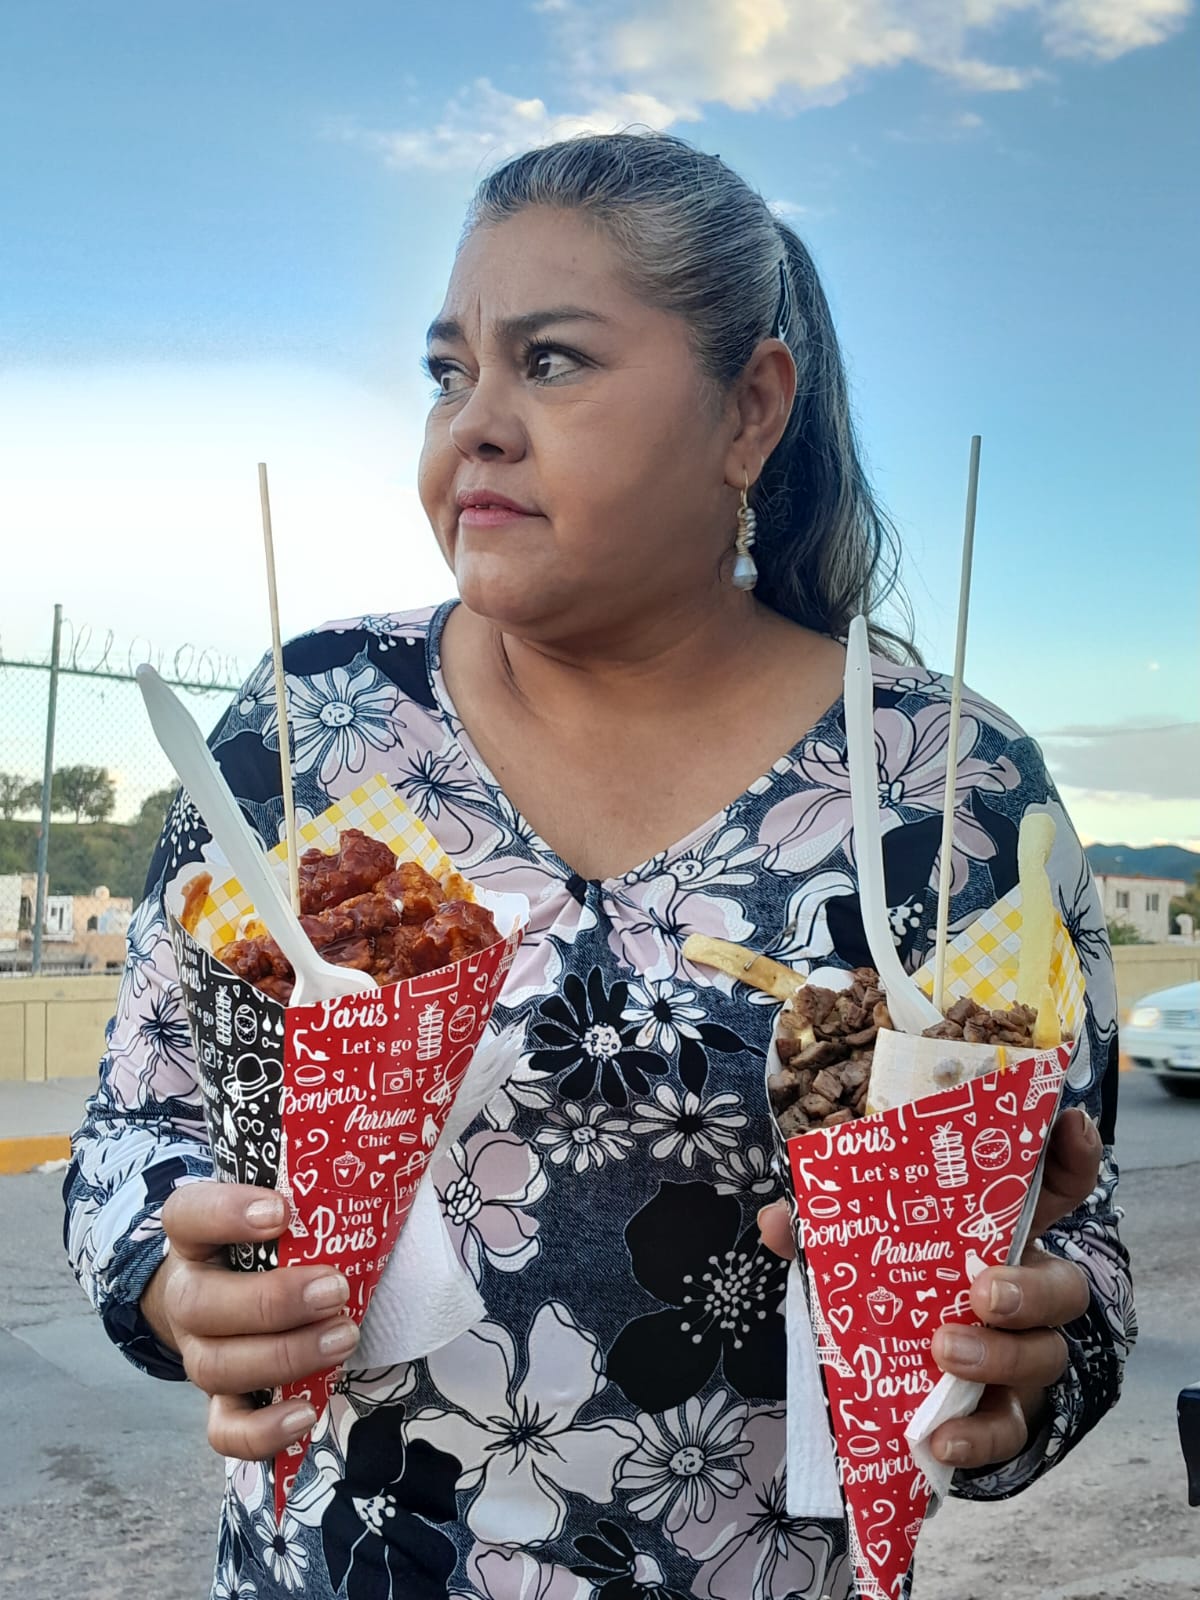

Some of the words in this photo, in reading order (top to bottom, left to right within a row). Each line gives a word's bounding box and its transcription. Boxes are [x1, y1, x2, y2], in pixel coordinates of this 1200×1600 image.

[391, 1039, 412, 1057] go
[344, 1104, 417, 1133] Parisian
[357, 1134, 391, 1149] Chic
[904, 1164, 929, 1183] go
[336, 1199, 343, 1214] I
[348, 1196, 382, 1213] love
[341, 1212, 373, 1231] you
[870, 1236, 955, 1266] Parisian
[888, 1268, 928, 1284] Chic
[879, 1337, 888, 1354] I
[892, 1336, 931, 1353] love
[886, 1353, 923, 1373] you
